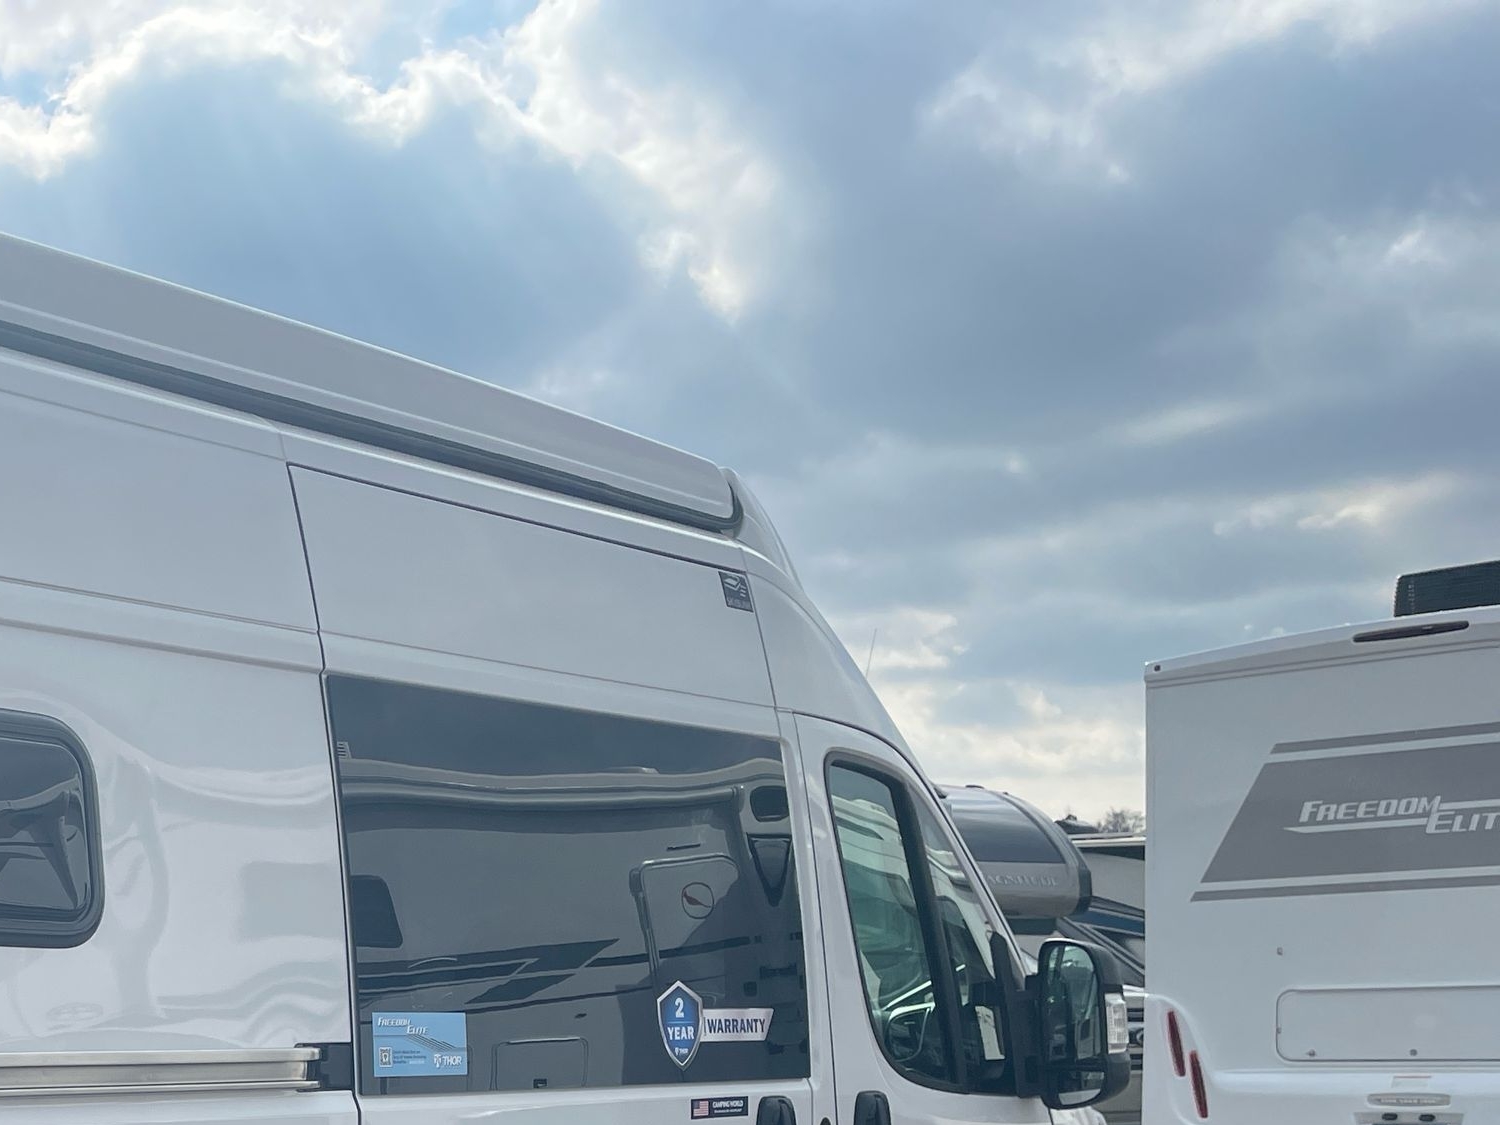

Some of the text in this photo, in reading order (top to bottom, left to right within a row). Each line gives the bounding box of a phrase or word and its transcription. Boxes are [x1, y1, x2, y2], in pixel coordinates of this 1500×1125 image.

[1299, 795, 1441, 822] FREEDOM
[674, 997, 685, 1018] 2
[406, 1025, 428, 1035] ELITE
[667, 1026, 695, 1041] YEAR
[707, 1018, 766, 1034] WARRANTY
[442, 1056, 462, 1067] THOR
